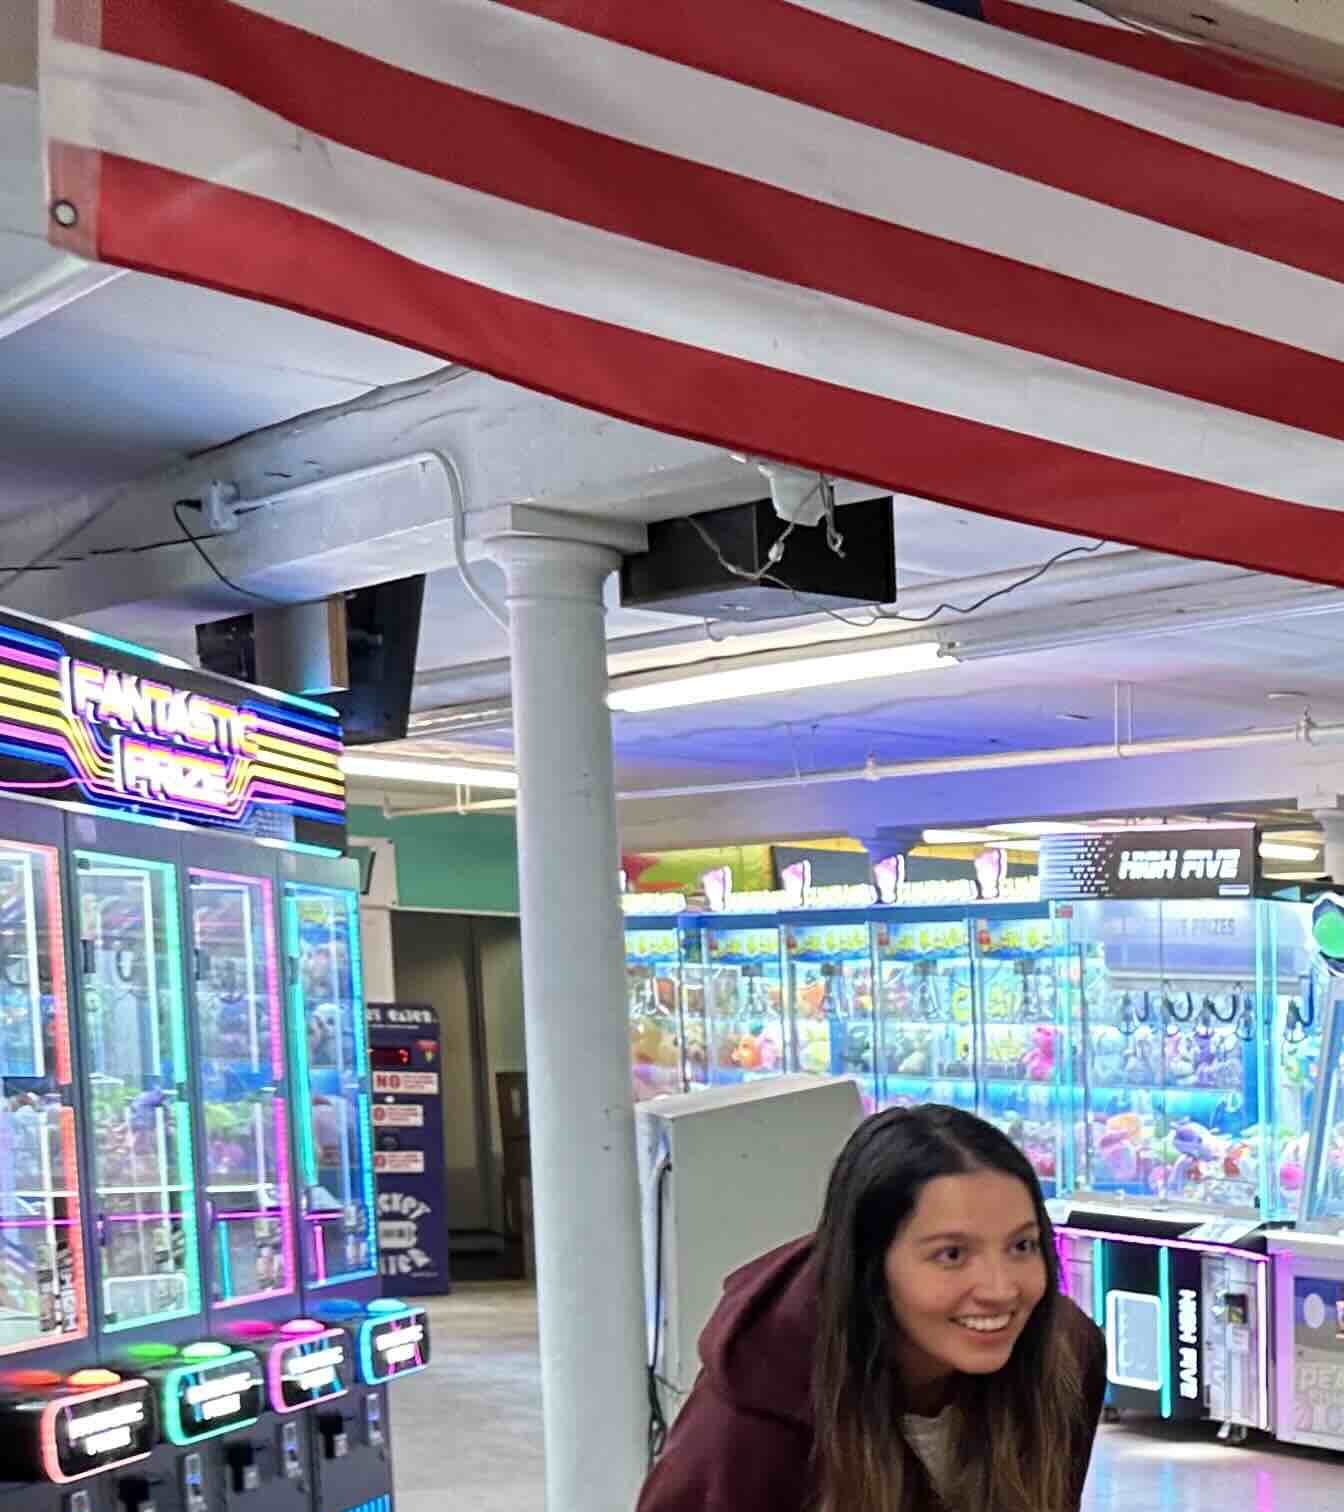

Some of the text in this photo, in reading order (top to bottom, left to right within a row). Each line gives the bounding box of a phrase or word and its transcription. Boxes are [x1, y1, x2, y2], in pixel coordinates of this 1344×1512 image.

[62, 656, 258, 760] FANTASTIC
[112, 735, 228, 807] PRIZE
[1117, 848, 1241, 880] HIGH FIVE
[1179, 1289, 1197, 1344] HIGH
[1179, 1347, 1198, 1399] FIVE
